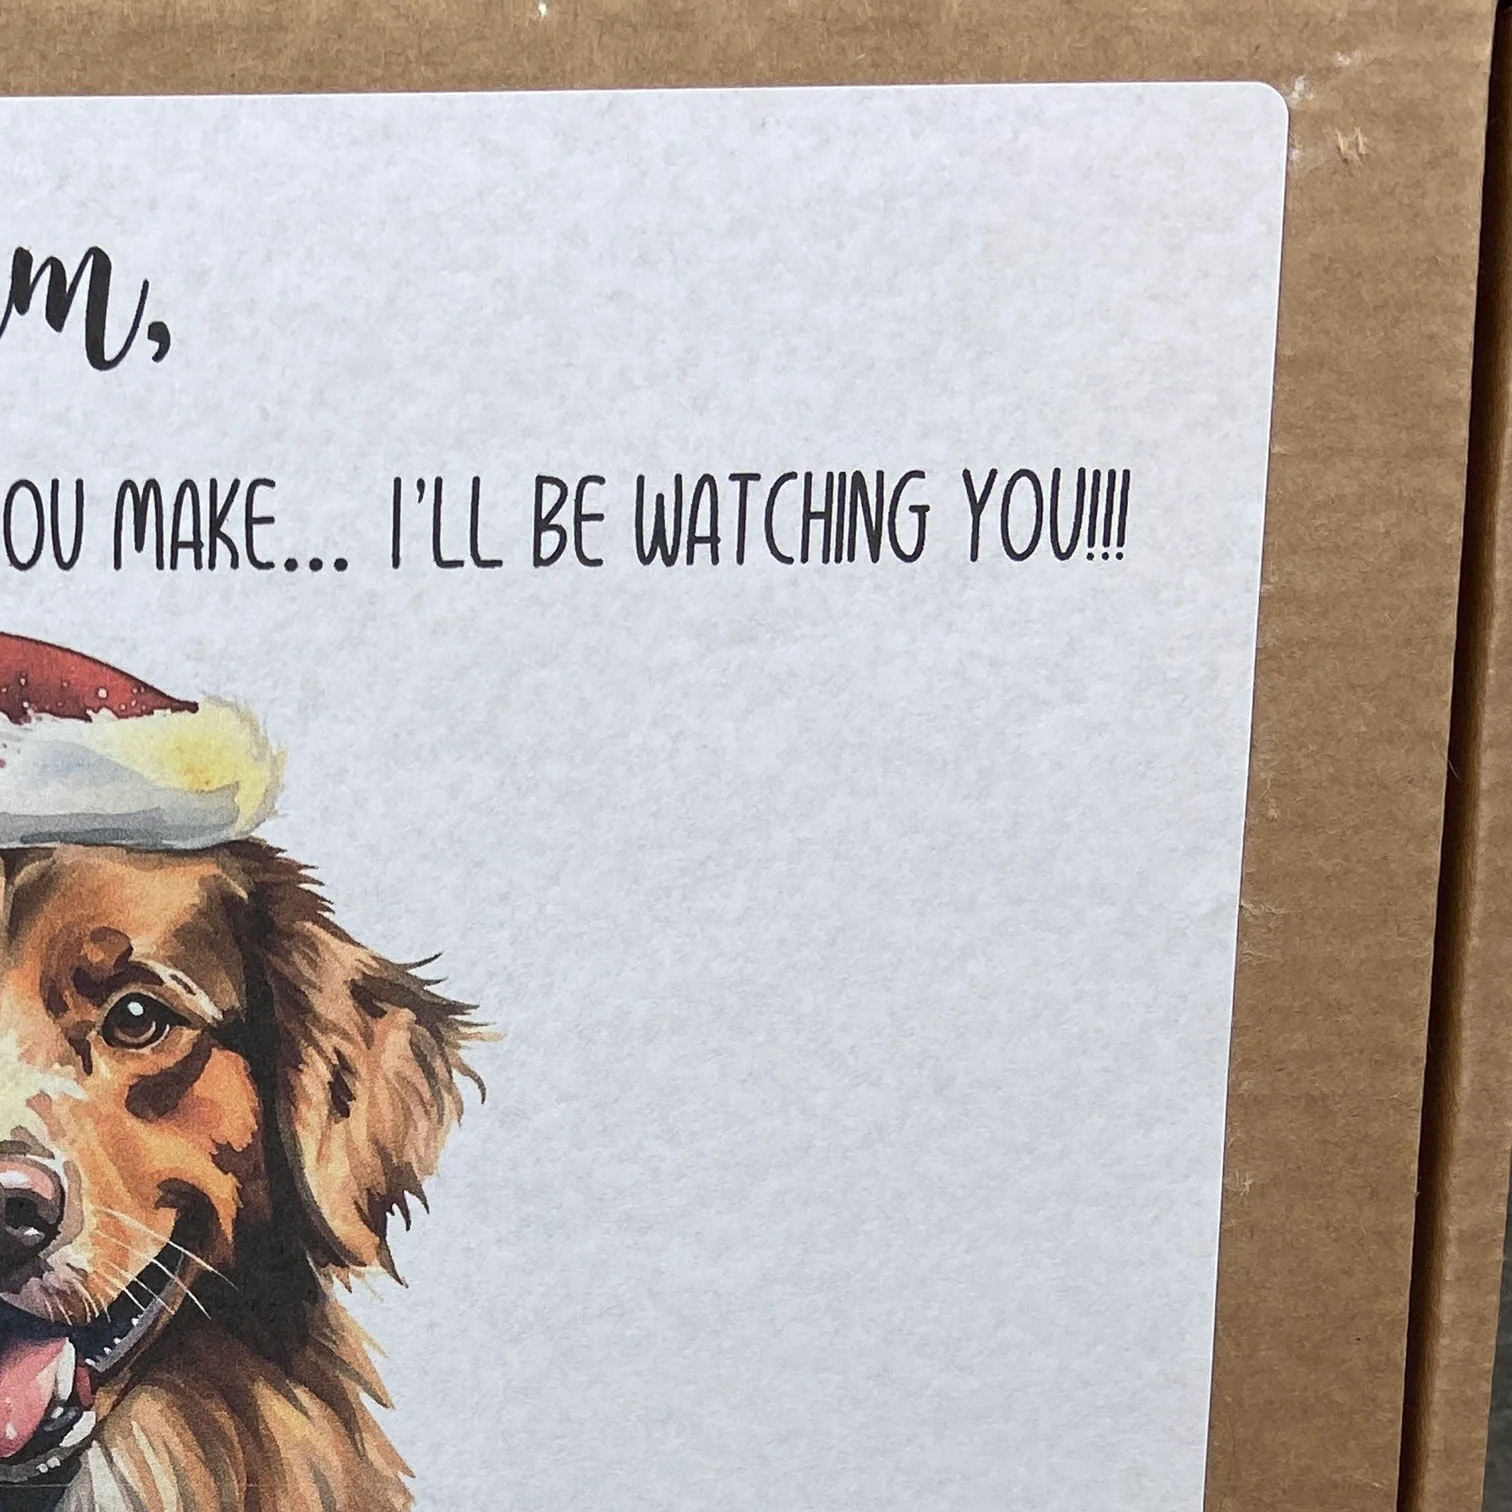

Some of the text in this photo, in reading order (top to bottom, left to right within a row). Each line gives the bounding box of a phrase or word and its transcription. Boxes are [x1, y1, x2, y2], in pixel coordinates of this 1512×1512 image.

[113, 477, 349, 572] MAKE...
[391, 475, 504, 570] I'LL
[532, 474, 606, 569] BE
[634, 469, 931, 568] WATCHING
[961, 466, 1131, 563] YOU!!!
